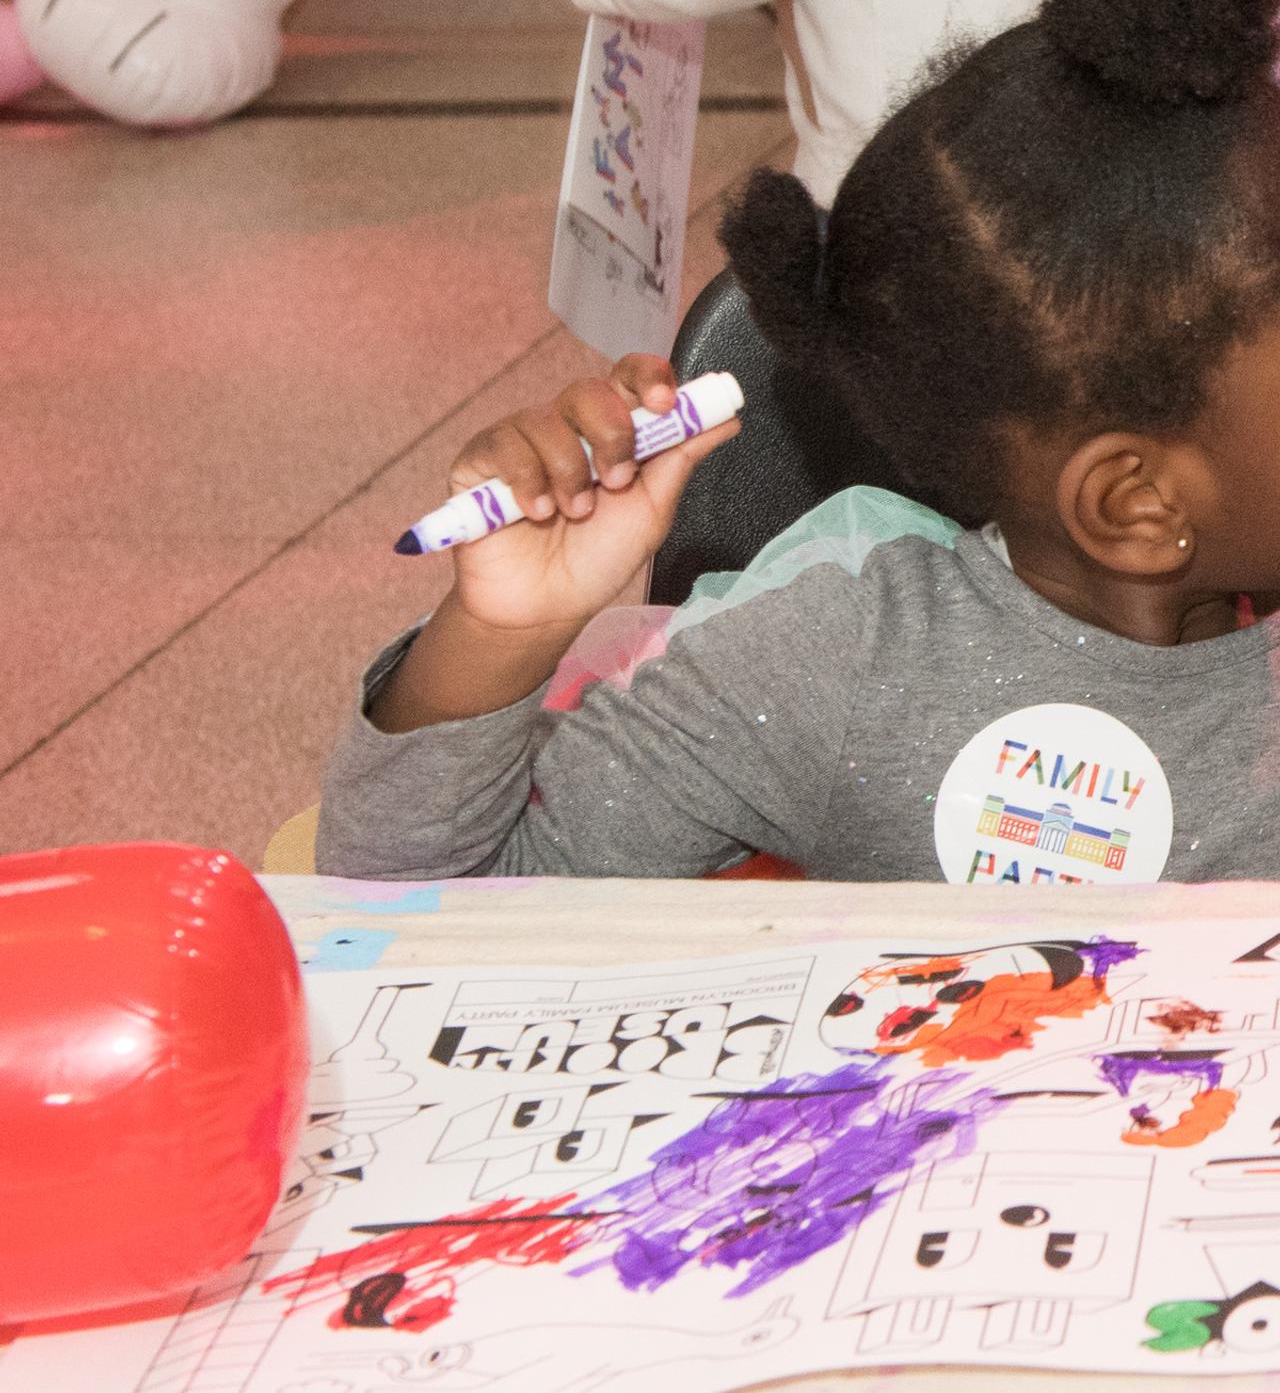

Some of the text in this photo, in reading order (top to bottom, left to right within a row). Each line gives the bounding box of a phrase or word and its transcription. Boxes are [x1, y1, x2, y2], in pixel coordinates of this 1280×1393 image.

[996, 739, 1145, 810] FAMILY
[454, 982, 798, 1023] BROOKLYN MUSEUM FAMILY PARTY
